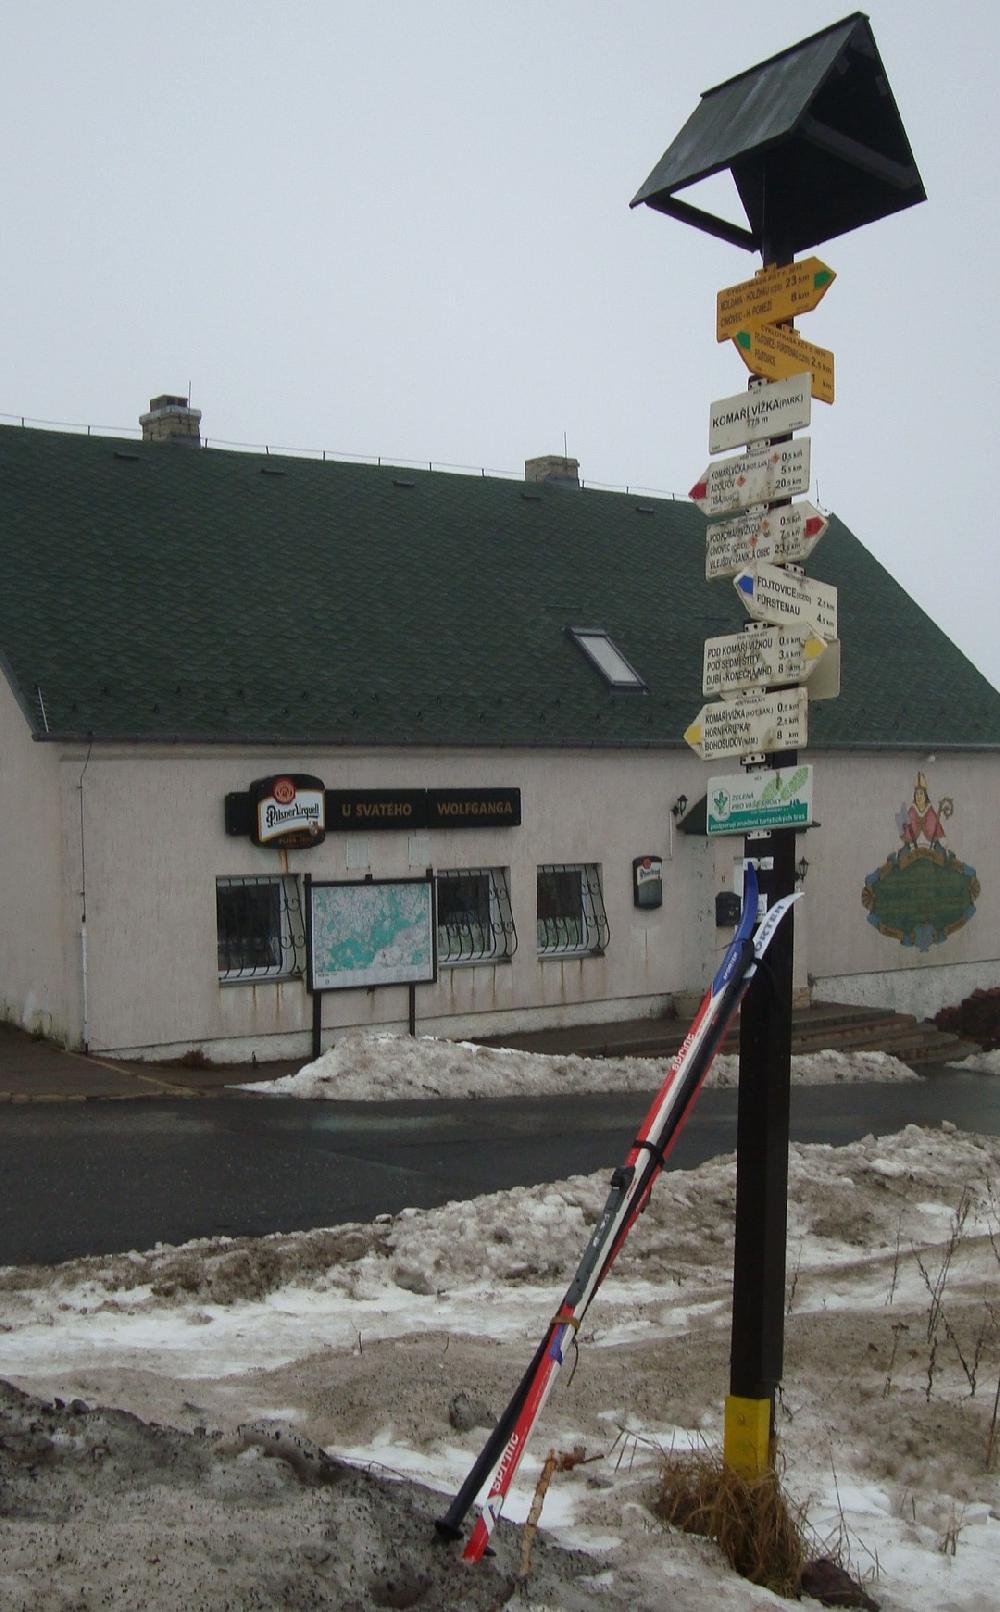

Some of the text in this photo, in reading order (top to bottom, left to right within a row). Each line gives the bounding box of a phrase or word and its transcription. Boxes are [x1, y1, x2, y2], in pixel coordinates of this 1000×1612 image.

[785, 275, 798, 288] 23
[757, 575, 797, 599] FOJTOVICE
[265, 802, 320, 829] Pilsner Urquell
[341, 801, 513, 816] U SVATÉHO WOLFGANGA
[755, 903, 786, 954] ORTEN
